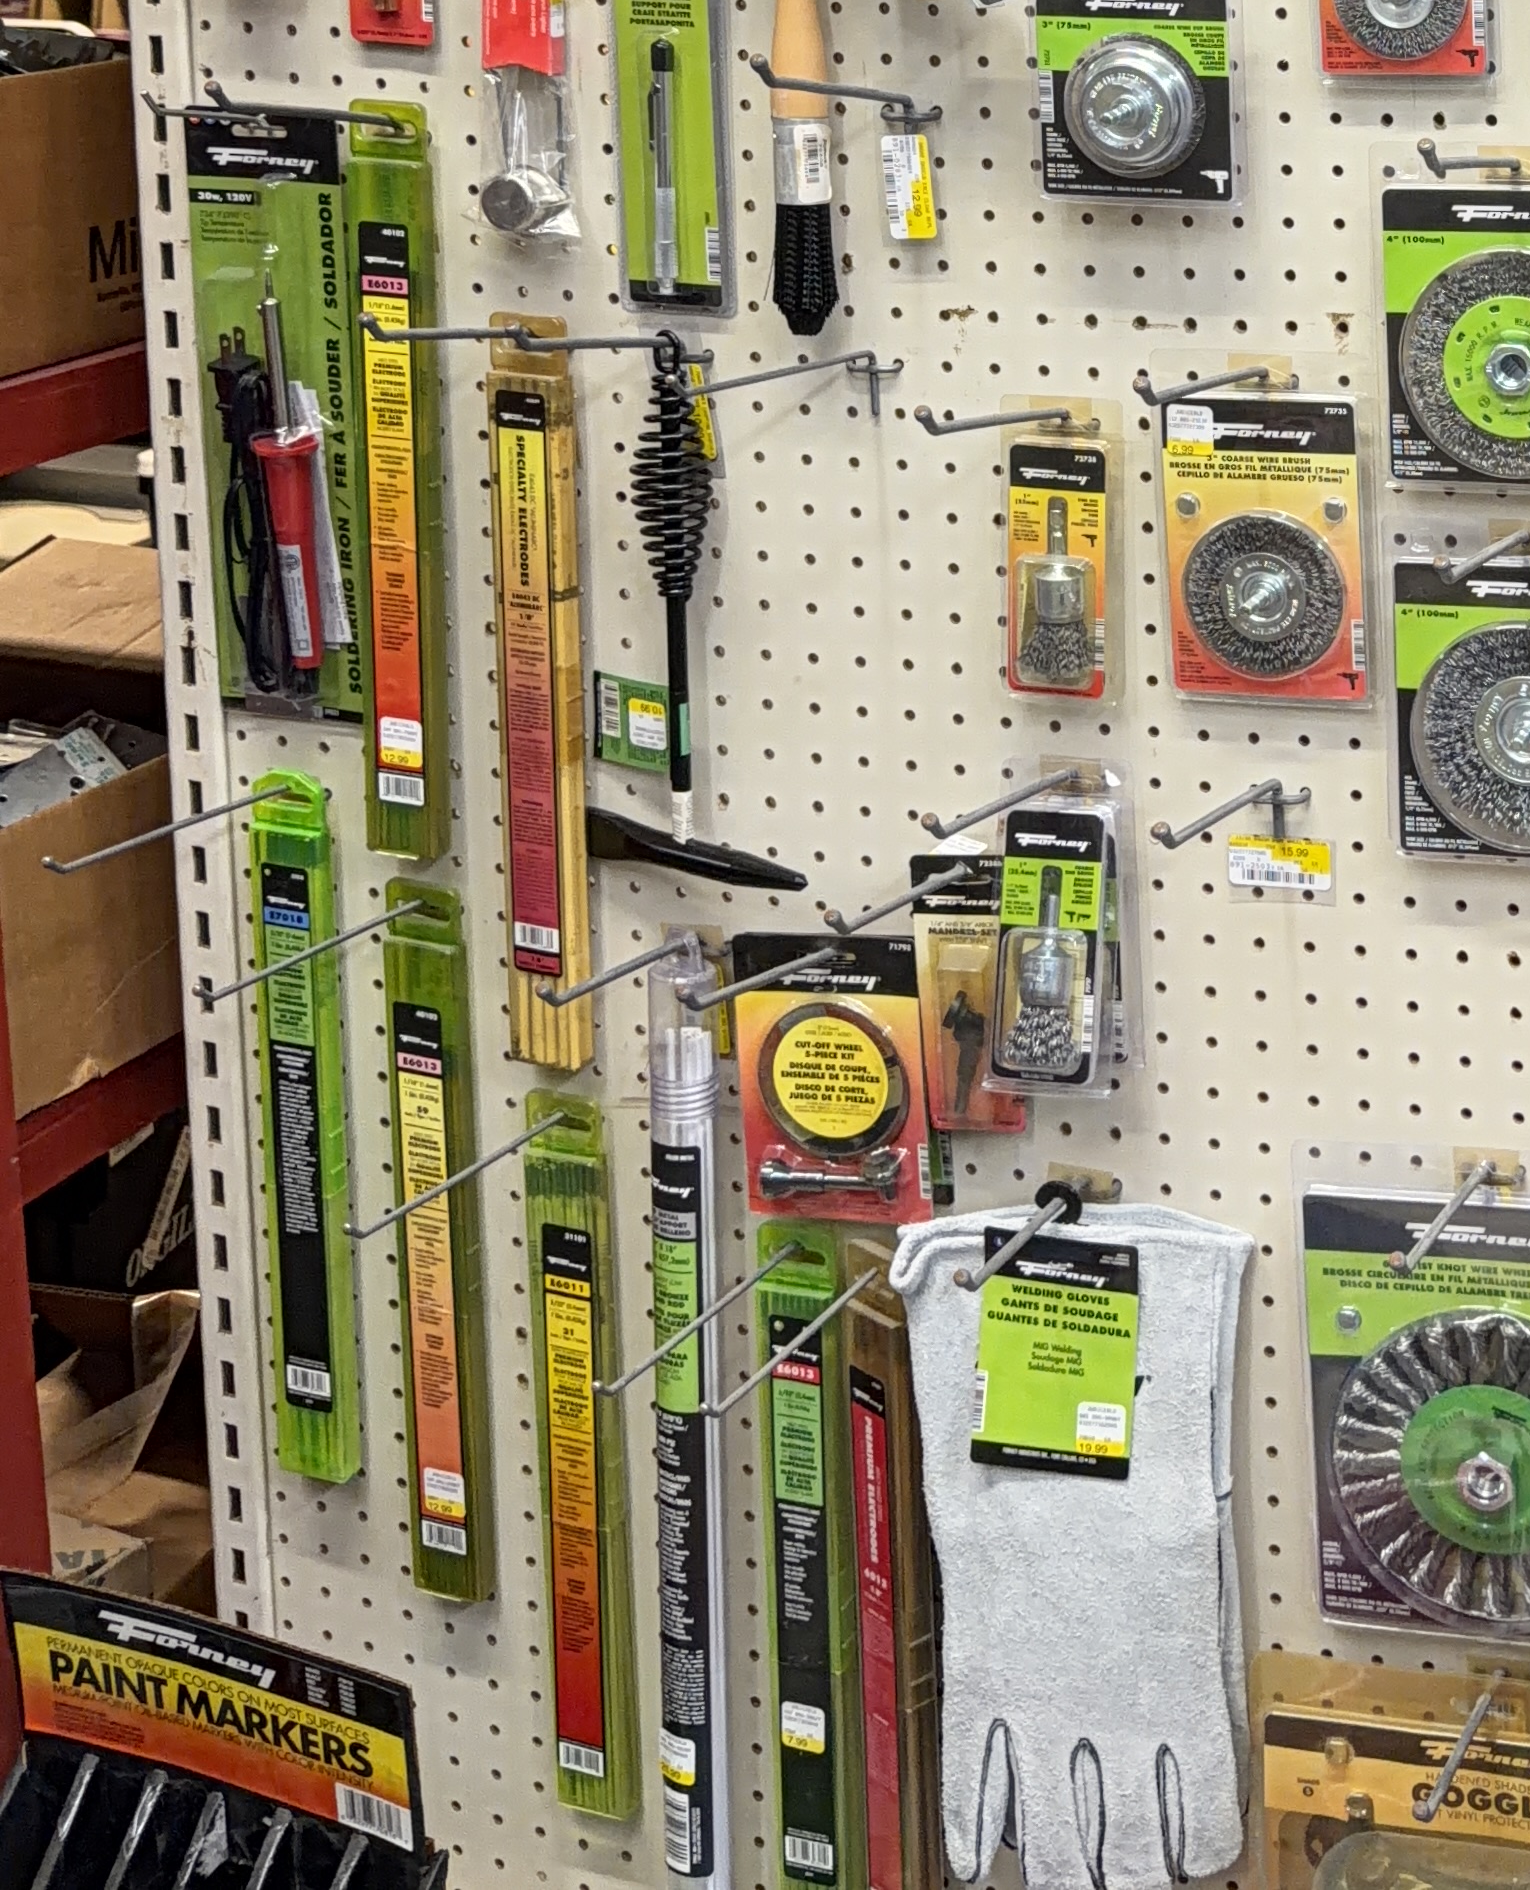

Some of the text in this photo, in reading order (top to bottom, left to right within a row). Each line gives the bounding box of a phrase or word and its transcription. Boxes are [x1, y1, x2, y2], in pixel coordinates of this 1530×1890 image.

[206, 146, 315, 174] Forney
[318, 192, 338, 309] SOLDADOR
[367, 279, 404, 291] E6013
[1172, 446, 1194, 454] 6.99
[516, 435, 530, 587] SPECIALTY ELECTRODES
[338, 516, 364, 696] SOLDERING IRON
[795, 1041, 863, 1052] CUT-OFF WHEEL
[1012, 1284, 1110, 1306] WELDING GLOVES
[1001, 1298, 1119, 1323] GANTS DE SOUDAGE
[987, 1311, 1131, 1339] GUANTES DE SOLDADURA
[1079, 1443, 1108, 1454] 19.99
[46, 1635, 371, 1745] PERMANENT OPAQUE COLORS ON MOST SURFACES
[48, 1649, 375, 1779] PAINT MARKERS
